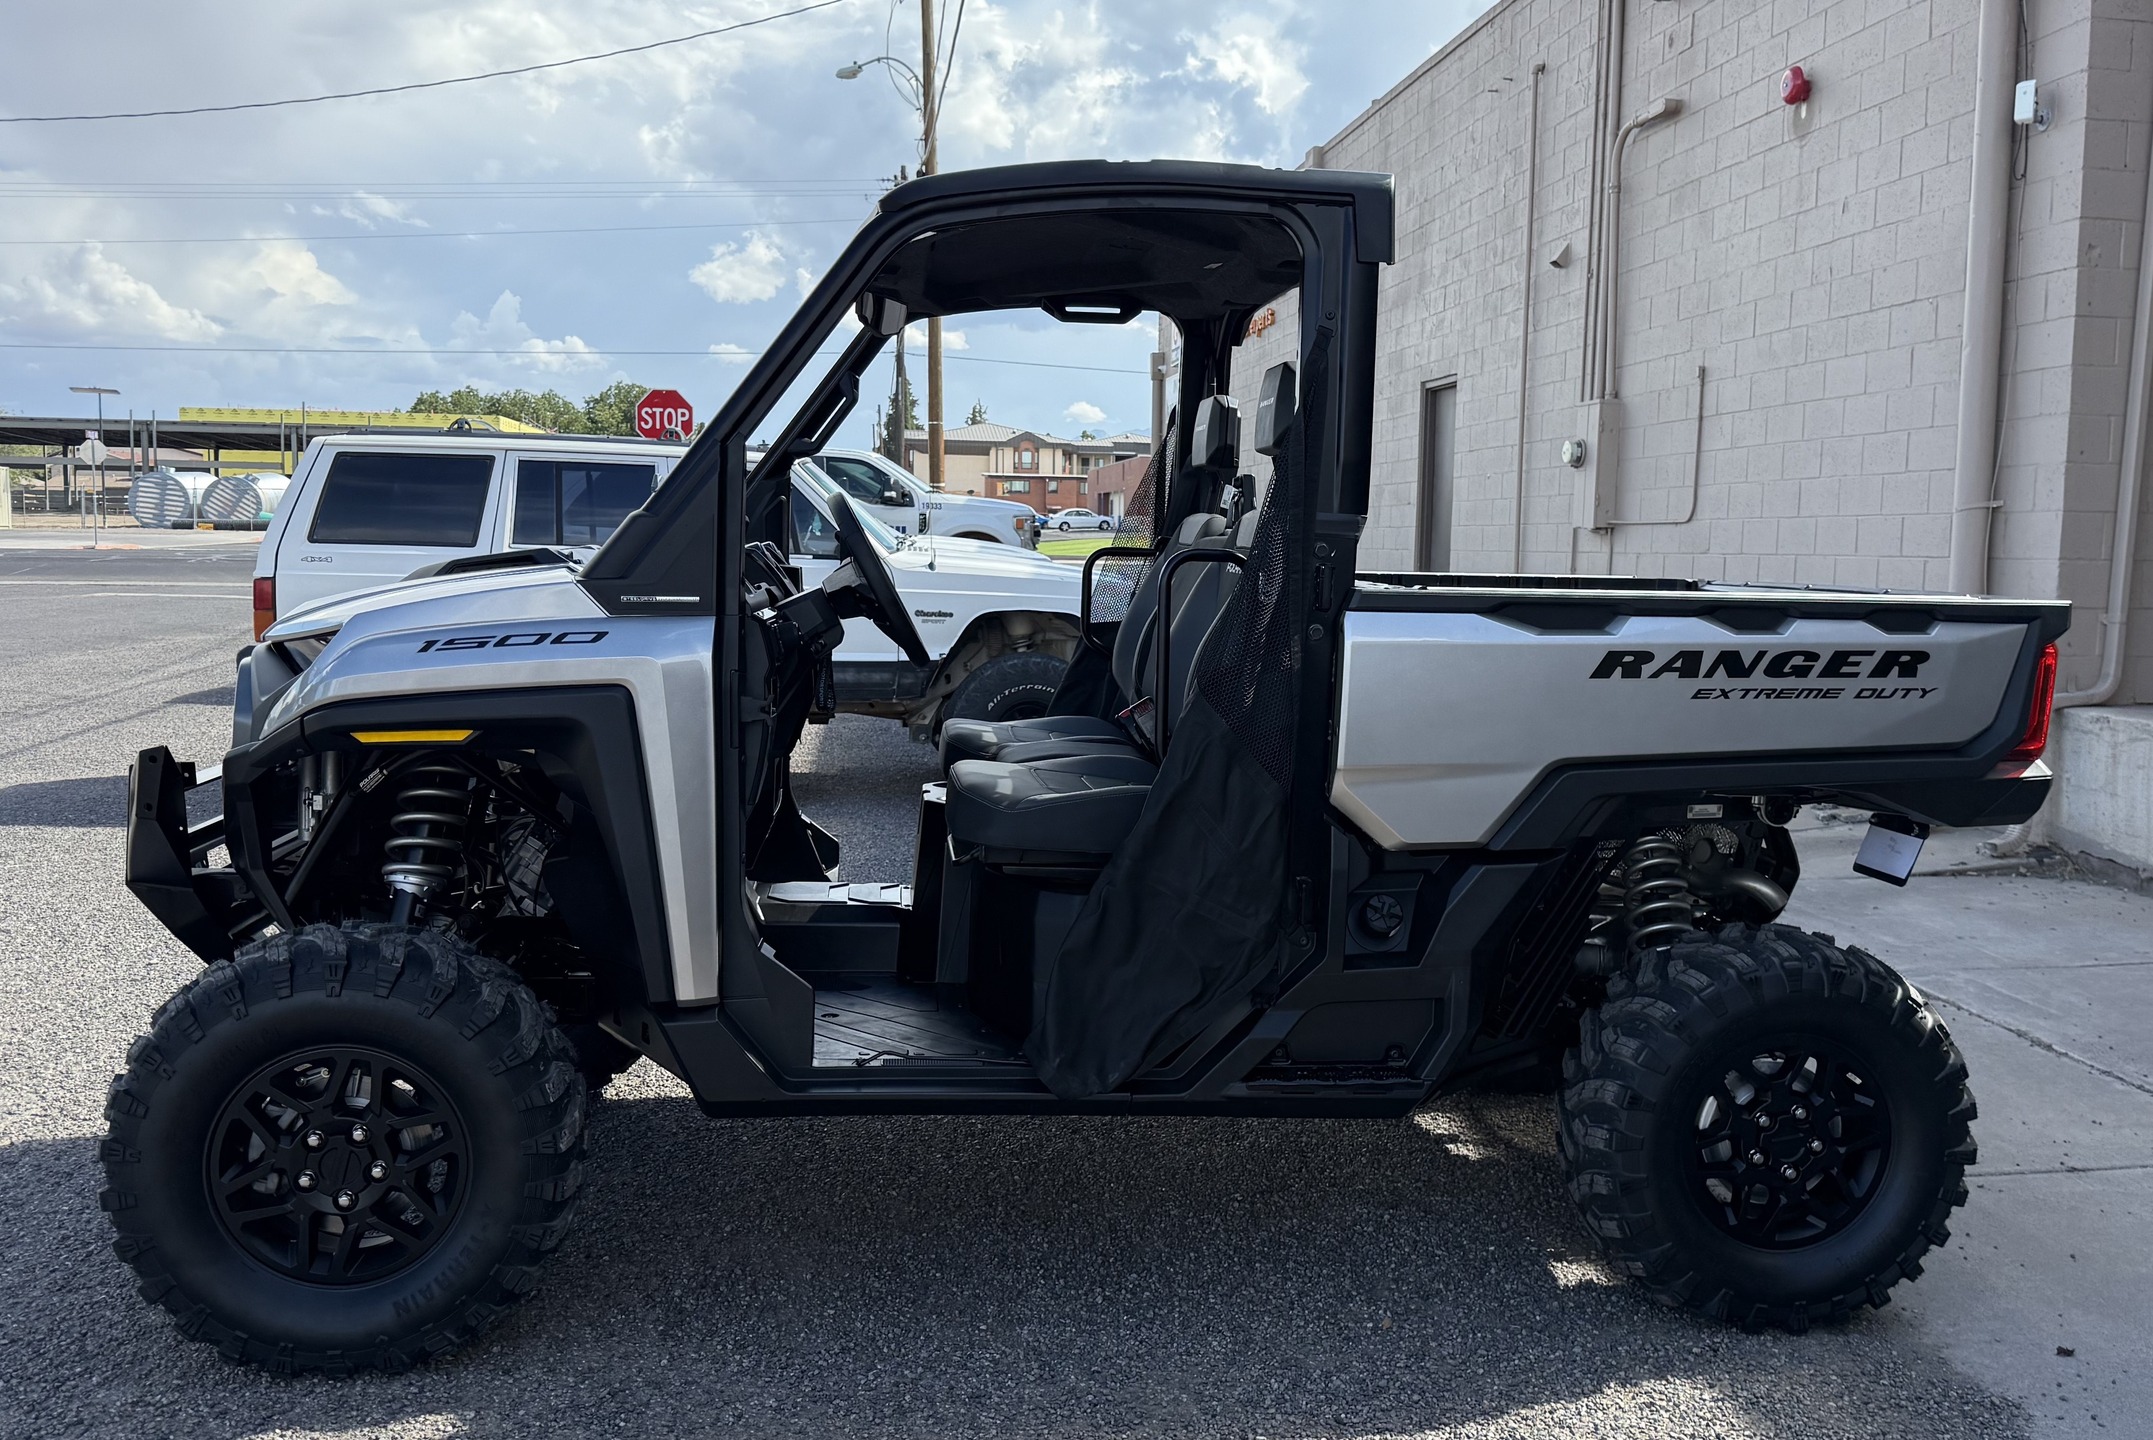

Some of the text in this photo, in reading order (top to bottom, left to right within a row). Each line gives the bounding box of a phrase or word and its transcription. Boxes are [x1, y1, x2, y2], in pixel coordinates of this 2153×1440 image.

[640, 407, 690, 430] STOP
[417, 631, 609, 653] 1500
[1588, 650, 1931, 679] RANGER
[1690, 687, 1939, 700] EXTREME DUTY
